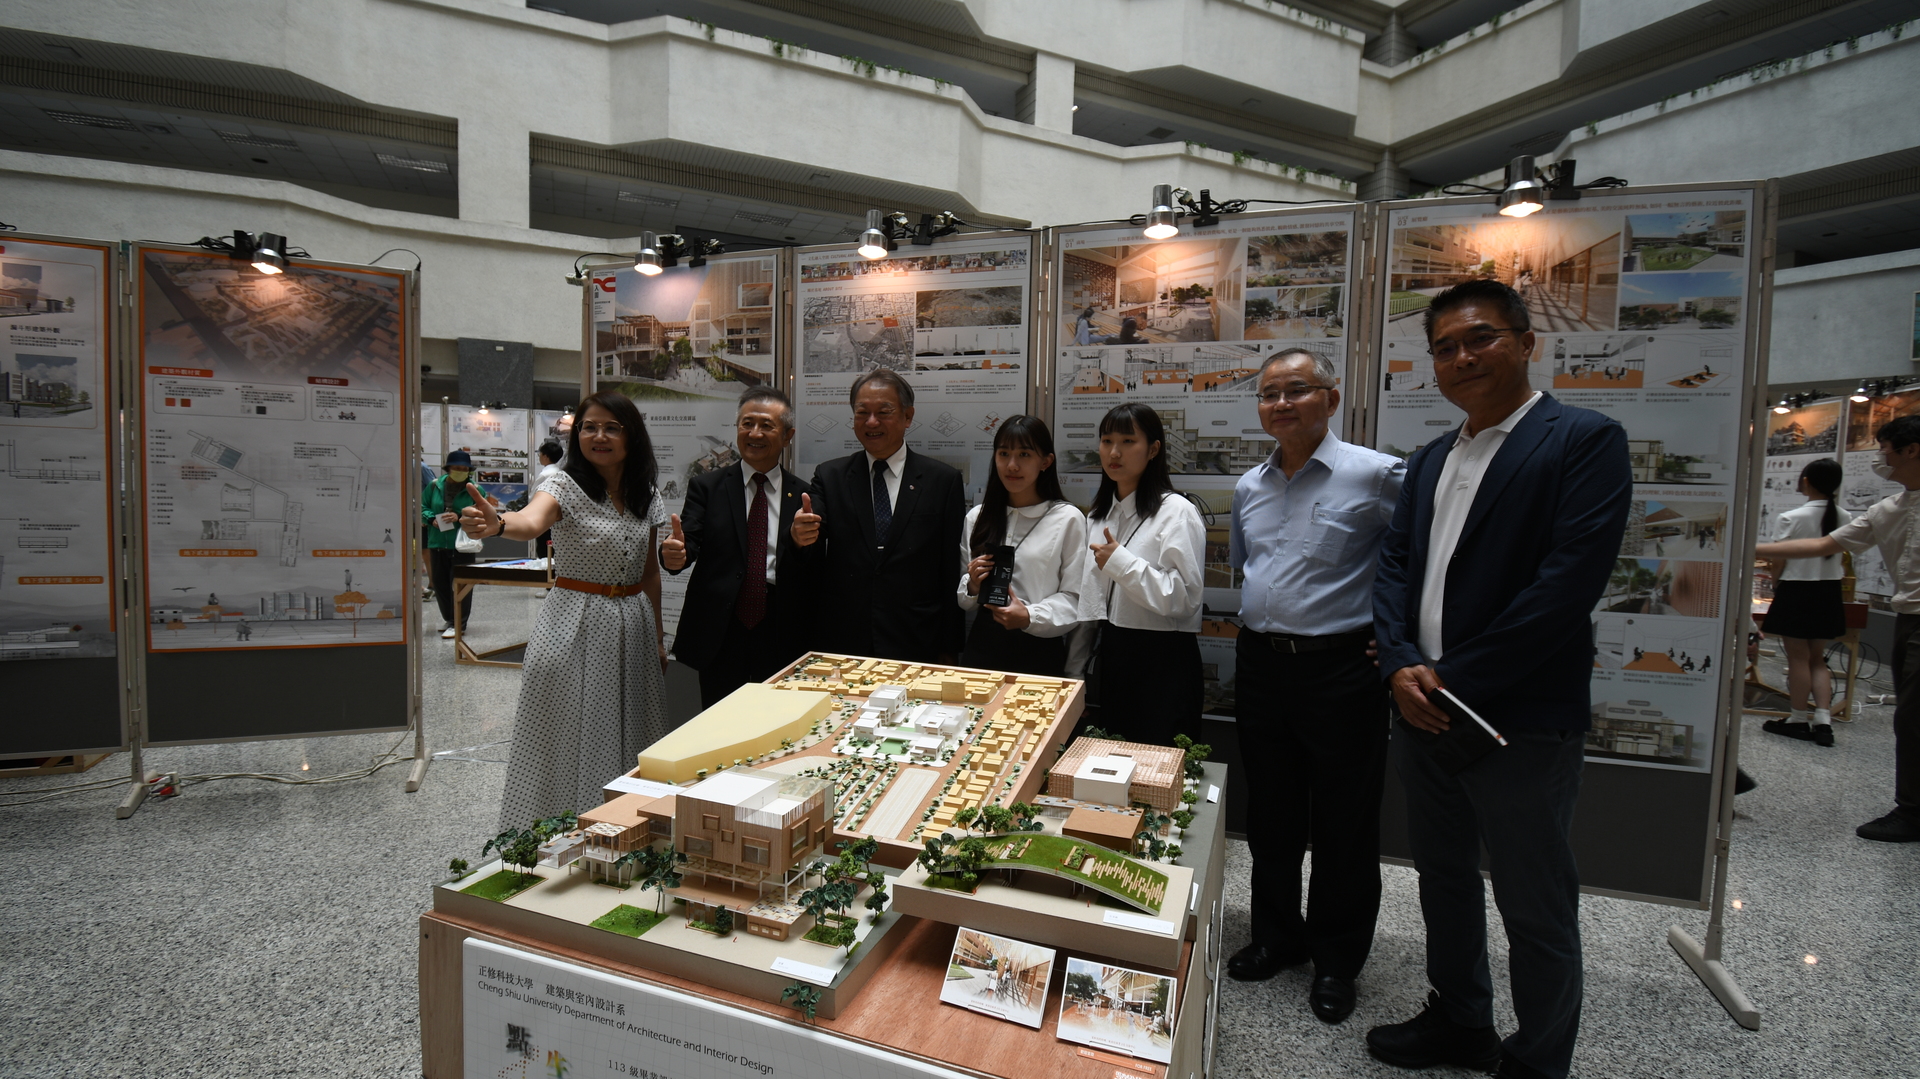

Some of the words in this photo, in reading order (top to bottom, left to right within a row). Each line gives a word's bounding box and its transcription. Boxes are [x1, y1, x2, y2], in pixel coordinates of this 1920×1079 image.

[478, 965, 534, 990] 正修科技大學
[545, 984, 626, 1016] 建築與室內設計系
[478, 980, 503, 998] Cheng
[504, 988, 522, 1001] Shiu
[523, 993, 563, 1014] University
[564, 1005, 615, 1028] Department
[616, 1019, 626, 1030] of
[627, 1023, 682, 1047] Architecture
[683, 1041, 701, 1053] and
[703, 1045, 738, 1063] Interior
[740, 1056, 774, 1076] Design
[506, 1023, 531, 1056] 點
[608, 1059, 626, 1073] 113
